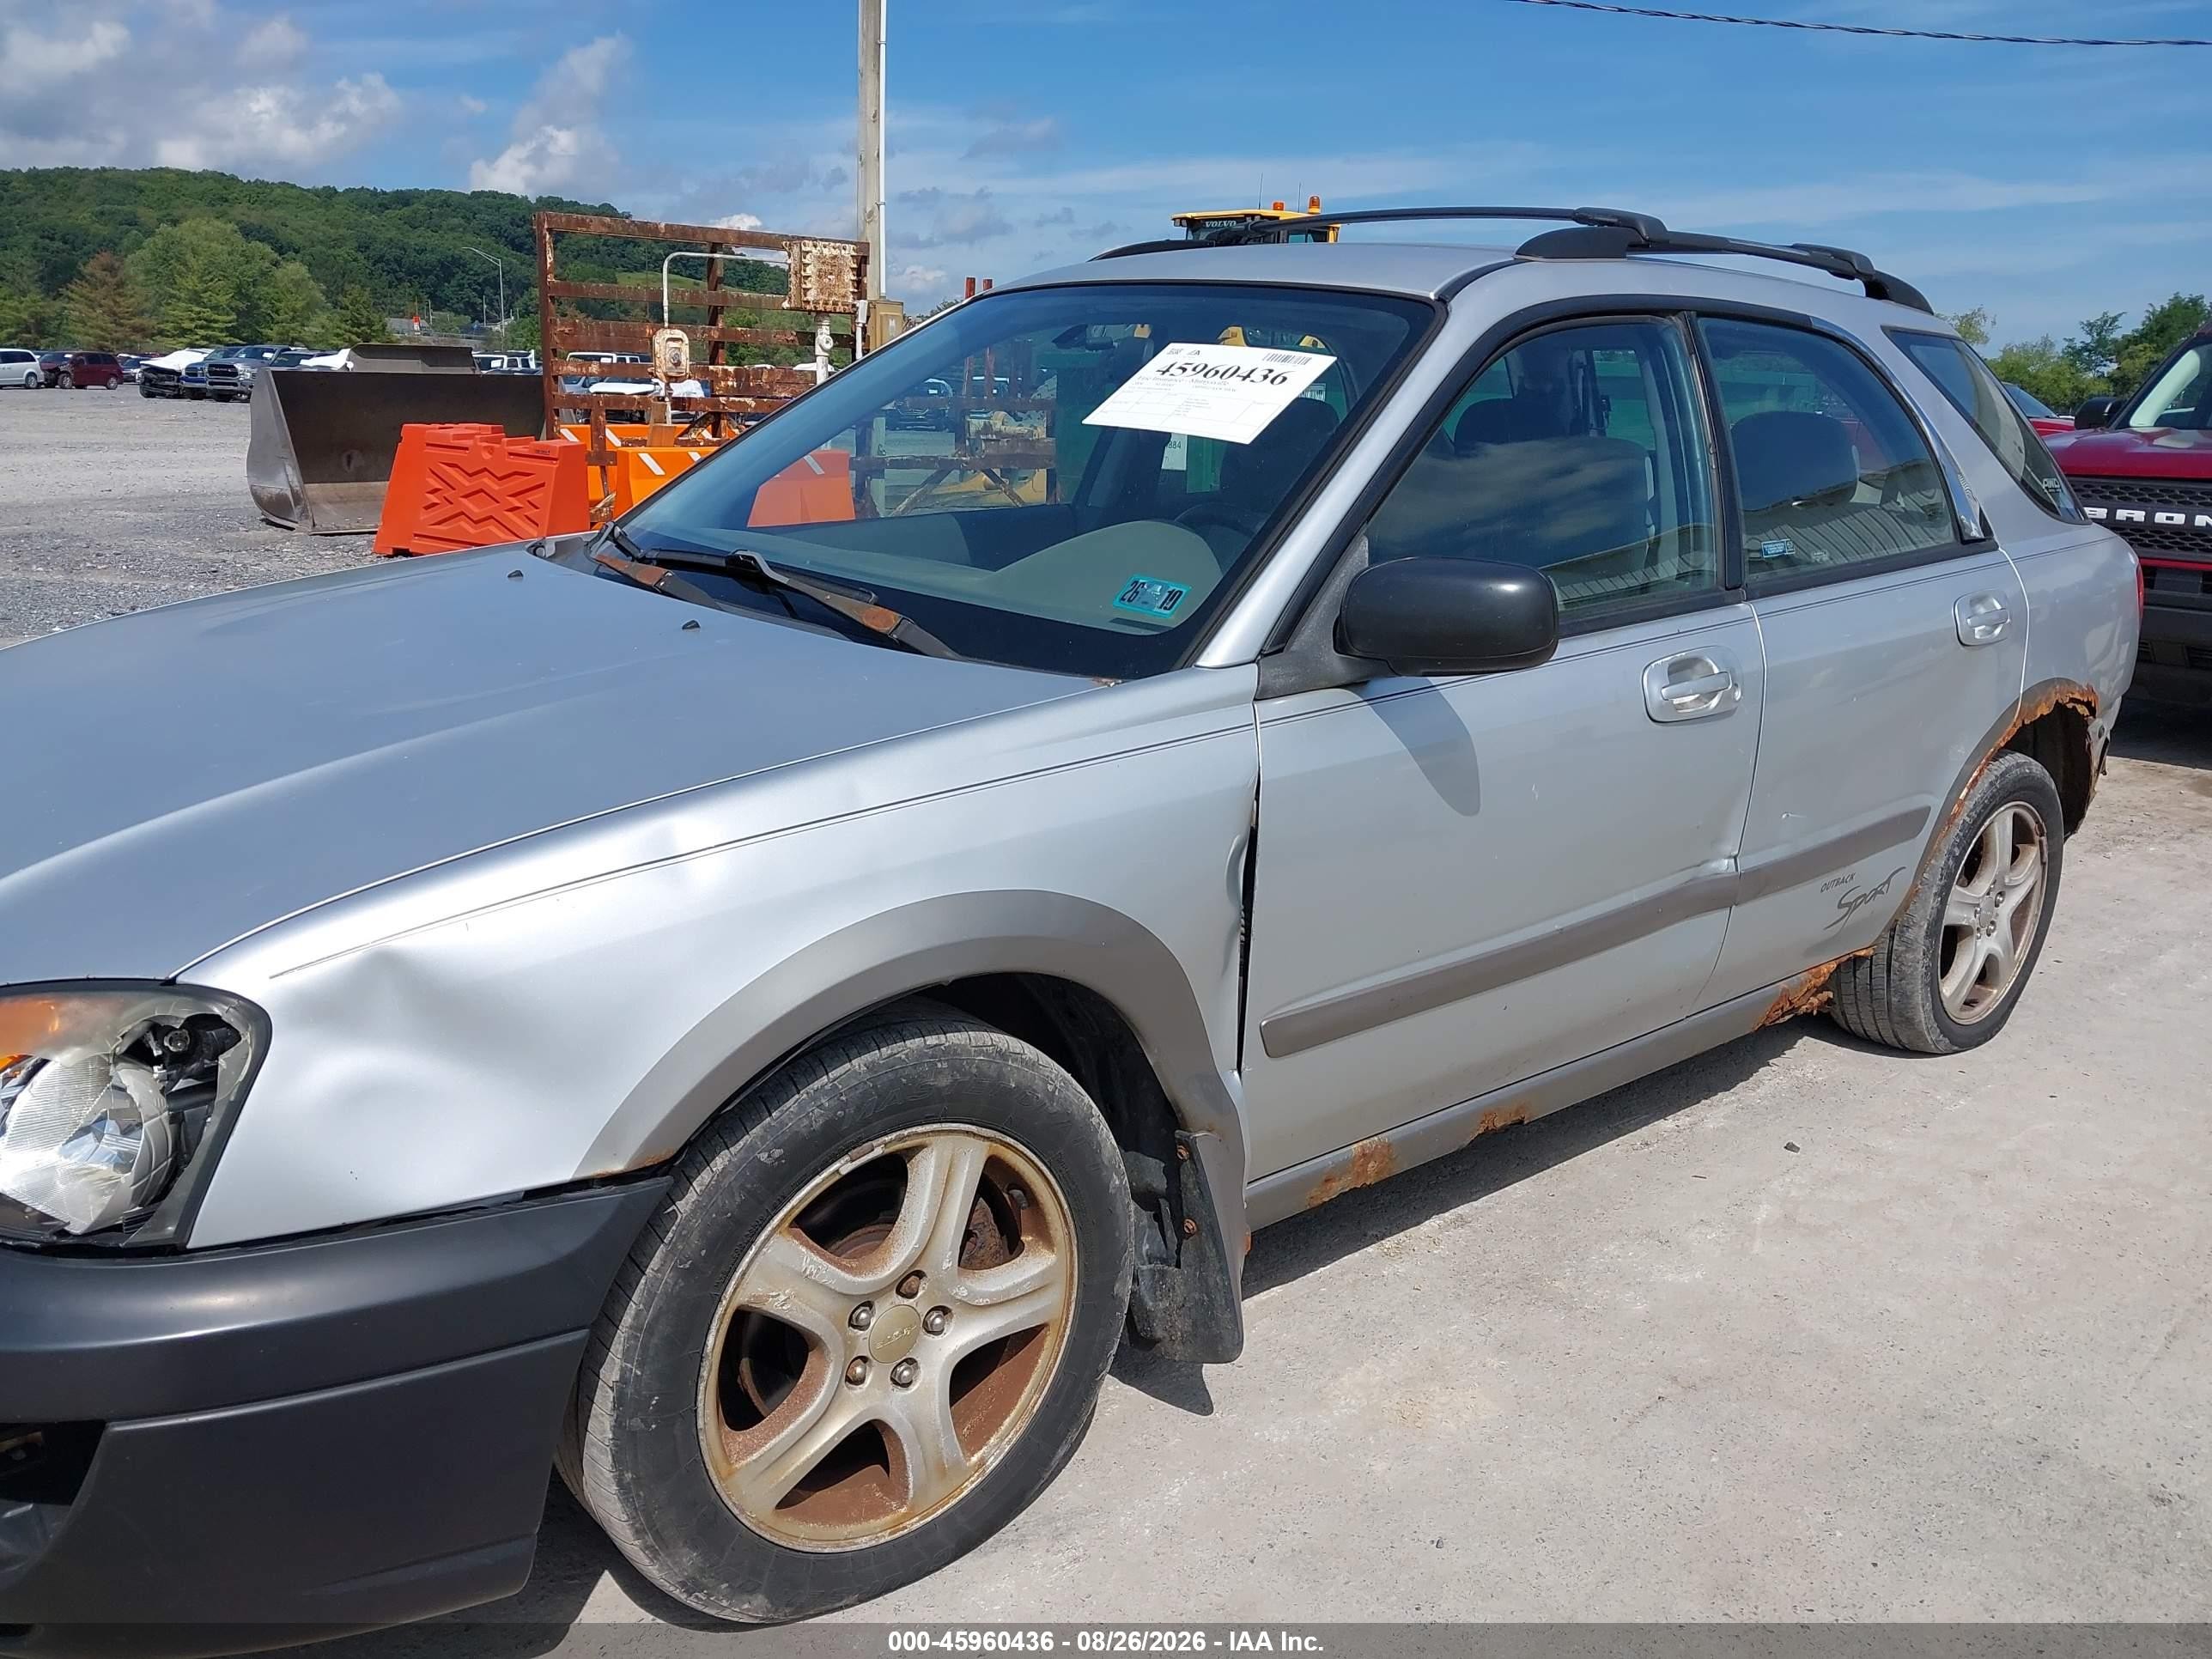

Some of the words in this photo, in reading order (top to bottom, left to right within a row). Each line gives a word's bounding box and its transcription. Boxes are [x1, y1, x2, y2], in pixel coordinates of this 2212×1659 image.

[1205, 220, 1237, 228] VOLVO
[1156, 361, 1294, 386] 45960436
[1820, 872, 1856, 893] OUTBACK
